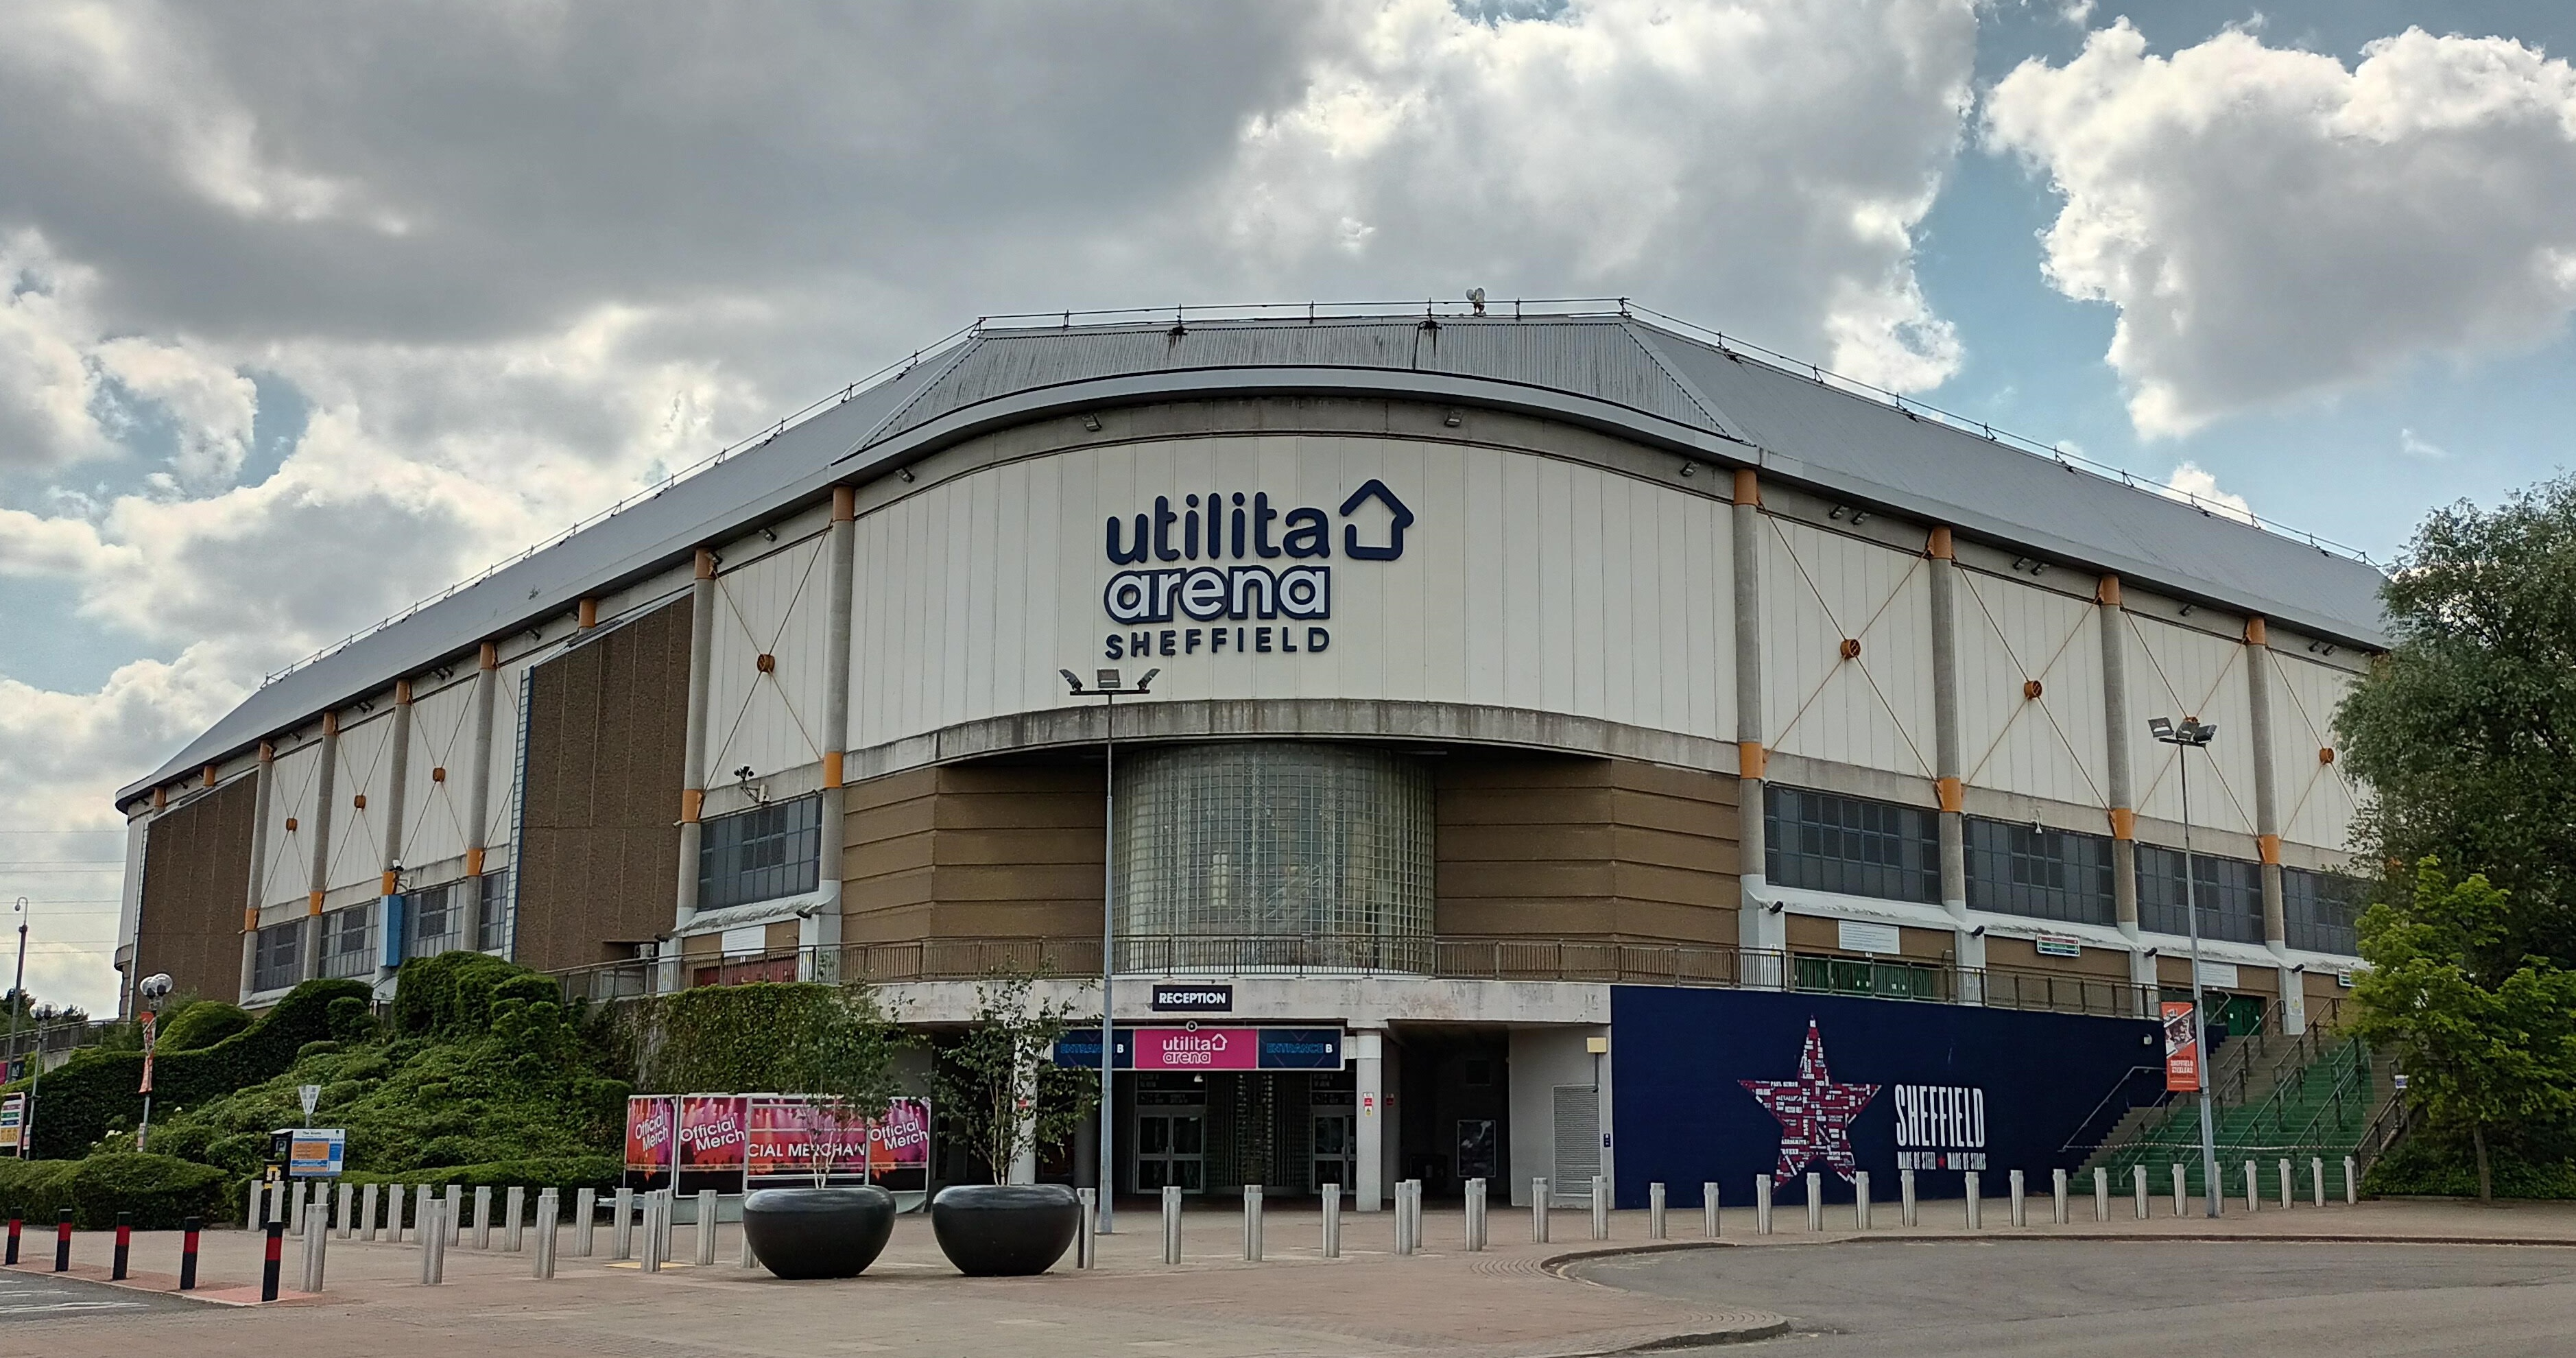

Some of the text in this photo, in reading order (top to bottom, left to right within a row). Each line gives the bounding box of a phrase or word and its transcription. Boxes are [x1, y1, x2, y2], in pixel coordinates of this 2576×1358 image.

[1107, 492, 1330, 565] utilita
[1104, 566, 1330, 623] arena
[1105, 627, 1330, 660] SHEFFIELD
[1159, 992, 1226, 1003] RECEPTION
[1117, 1044, 1124, 1053] B
[1162, 1036, 1211, 1051] utilita
[1267, 1043, 1333, 1053] ENTRANCE B
[1162, 1051, 1211, 1064] arena
[635, 1114, 664, 1140] Official
[1895, 1084, 1985, 1147] SHEFFIELD
[643, 1125, 669, 1152] Merch
[680, 1117, 736, 1142] Official
[695, 1129, 746, 1152] Merch
[871, 1118, 919, 1141] Official
[884, 1129, 928, 1151] Merch
[1898, 1152, 1986, 1170] MADE OF STEEL MADE OF STARS
